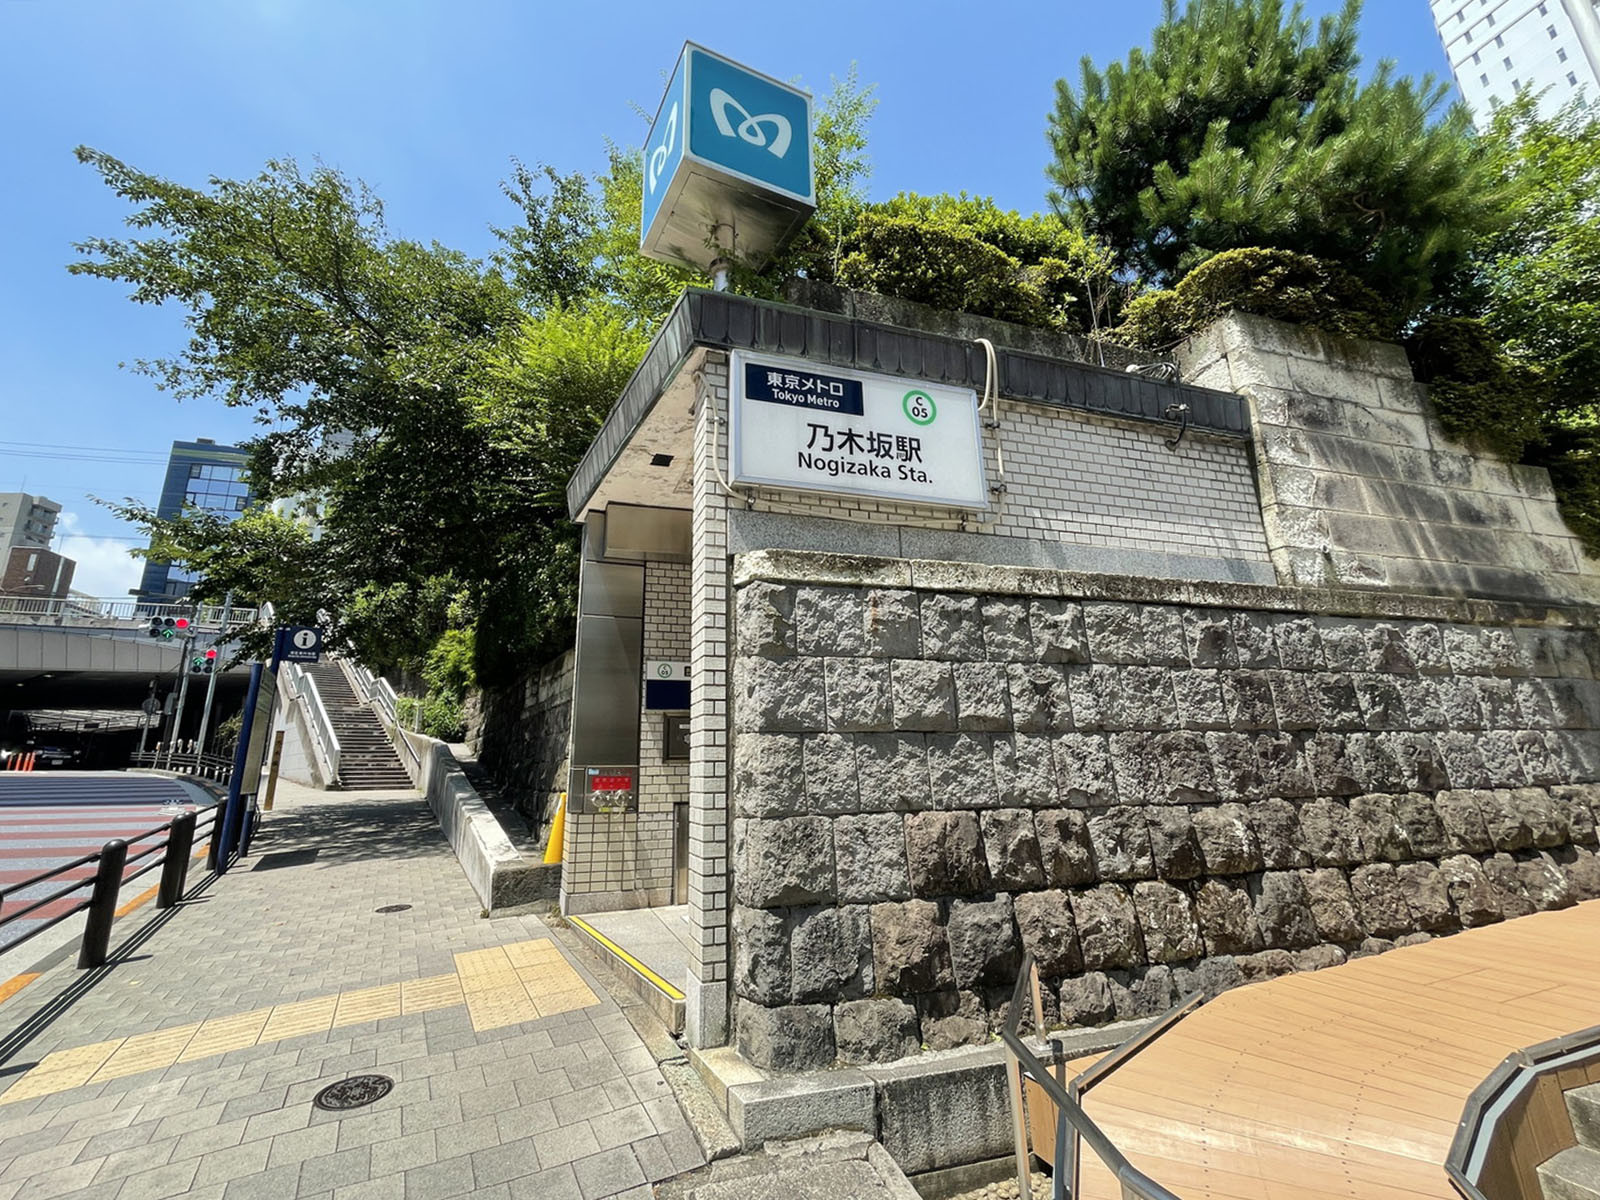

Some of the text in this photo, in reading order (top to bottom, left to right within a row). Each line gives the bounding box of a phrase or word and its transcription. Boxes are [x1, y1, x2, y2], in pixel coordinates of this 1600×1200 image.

[767, 371, 844, 396] 東京メトロ
[772, 388, 840, 408] Tokyo Metro
[915, 396, 923, 406] C
[912, 406, 928, 418] 05
[807, 423, 922, 463] 乃木坂駅
[798, 451, 933, 484] Nogizaka Sta.
